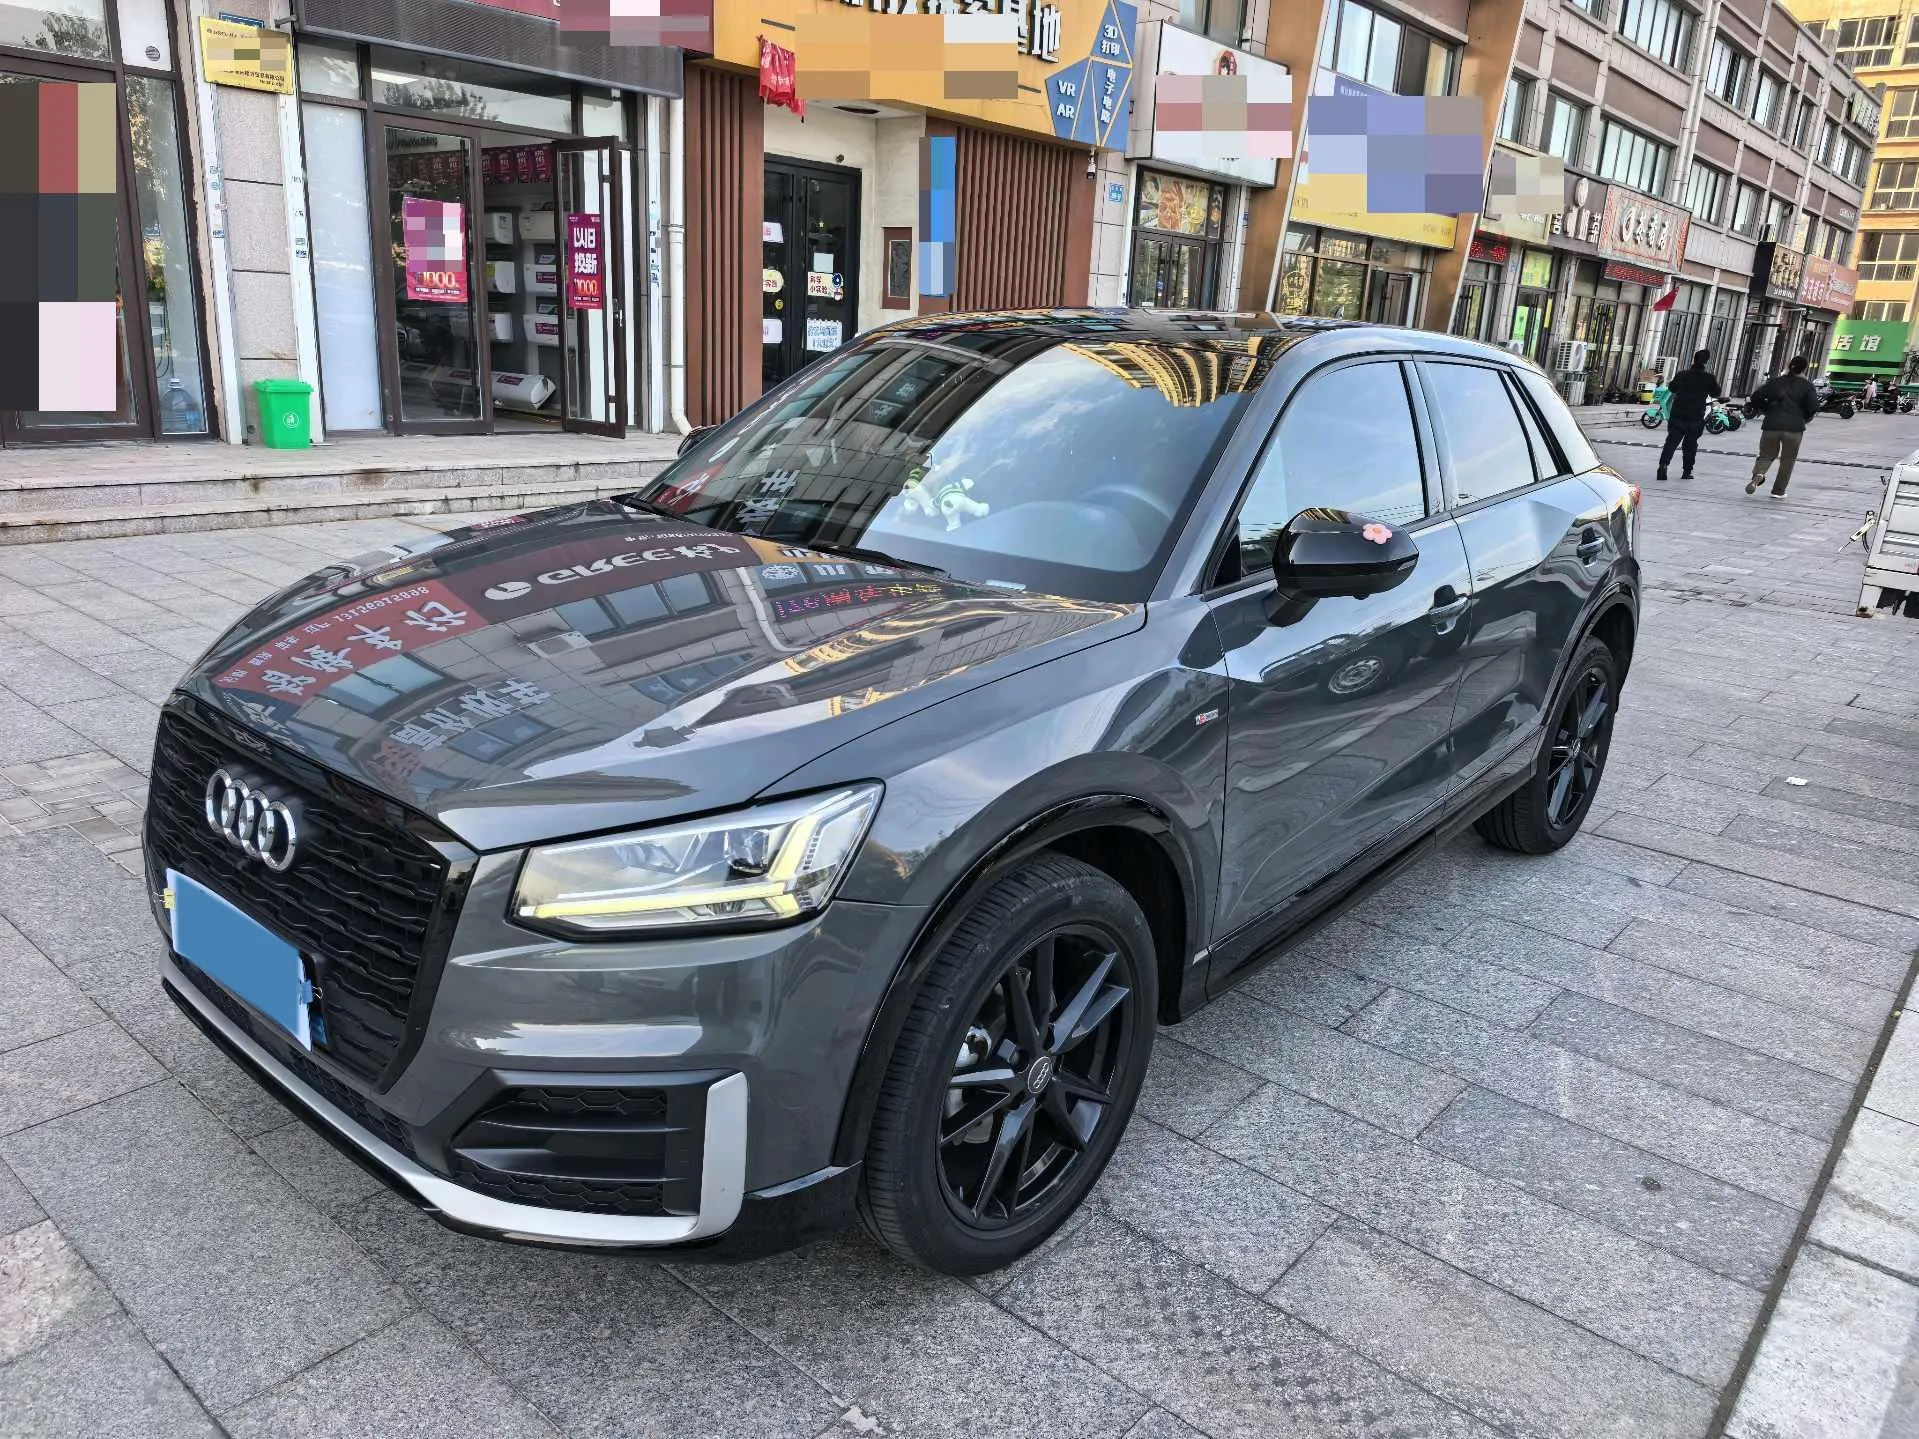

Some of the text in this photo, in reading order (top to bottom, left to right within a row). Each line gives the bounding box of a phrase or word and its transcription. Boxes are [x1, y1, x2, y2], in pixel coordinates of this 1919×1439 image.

[1104, 24, 1118, 39] 3D
[1101, 39, 1120, 56] 打印
[1058, 80, 1076, 96] VR
[1057, 103, 1075, 118] AR
